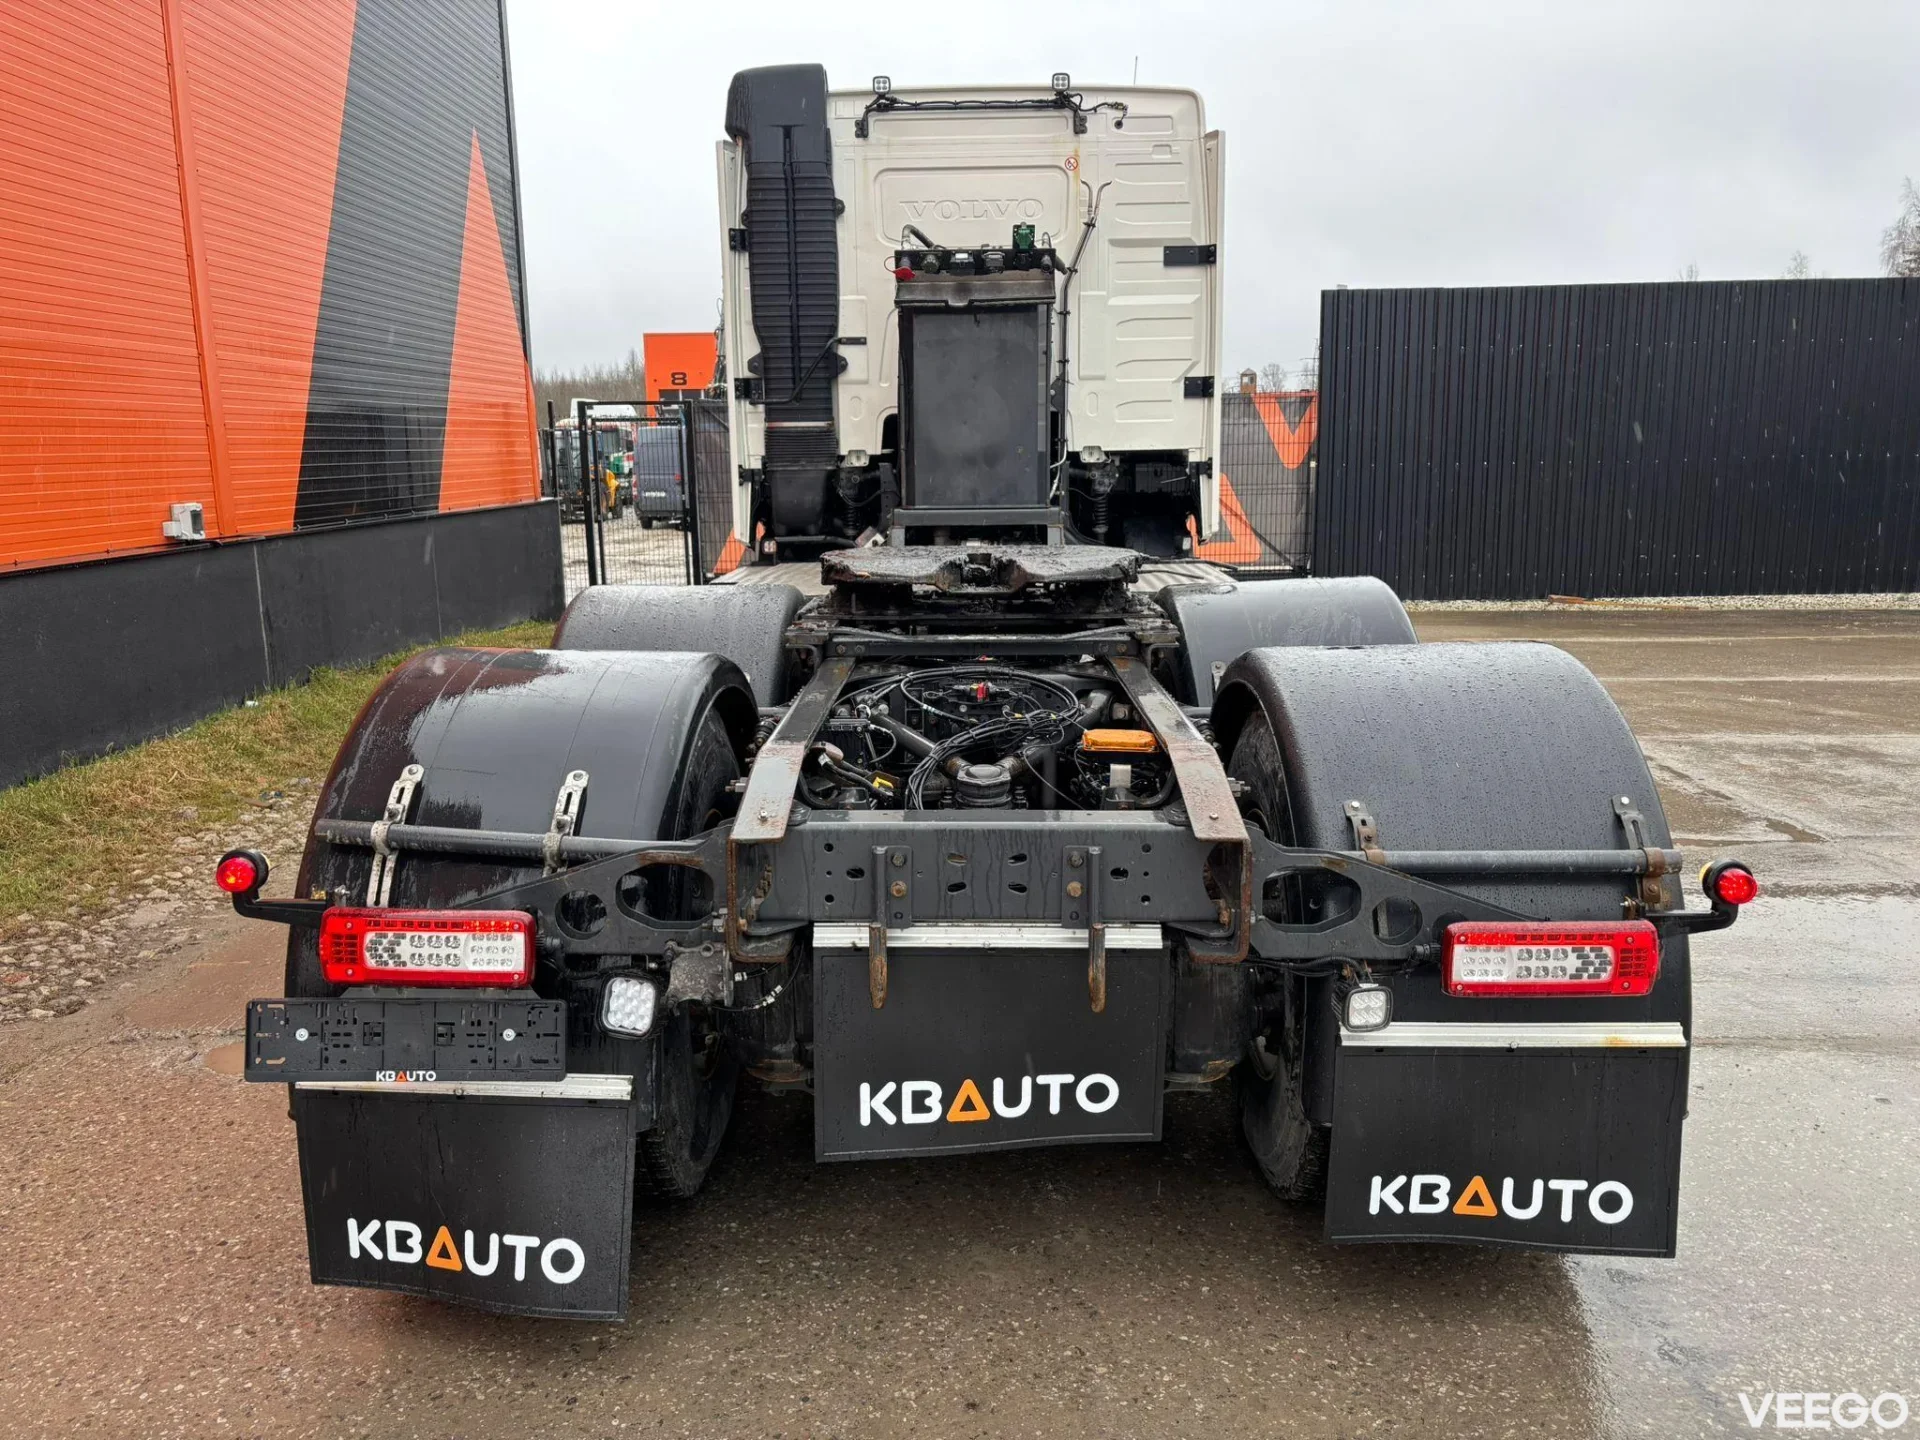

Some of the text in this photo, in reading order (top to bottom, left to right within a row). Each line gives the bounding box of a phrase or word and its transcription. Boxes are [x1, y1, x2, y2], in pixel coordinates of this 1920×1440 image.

[899, 199, 1044, 222] VOLVO
[671, 372, 687, 386] 8
[375, 1070, 437, 1082] KBAUTO
[859, 1073, 1120, 1127] KBAUTO
[1368, 1174, 1634, 1225] KBAUTO
[346, 1217, 586, 1285] KBAUTO
